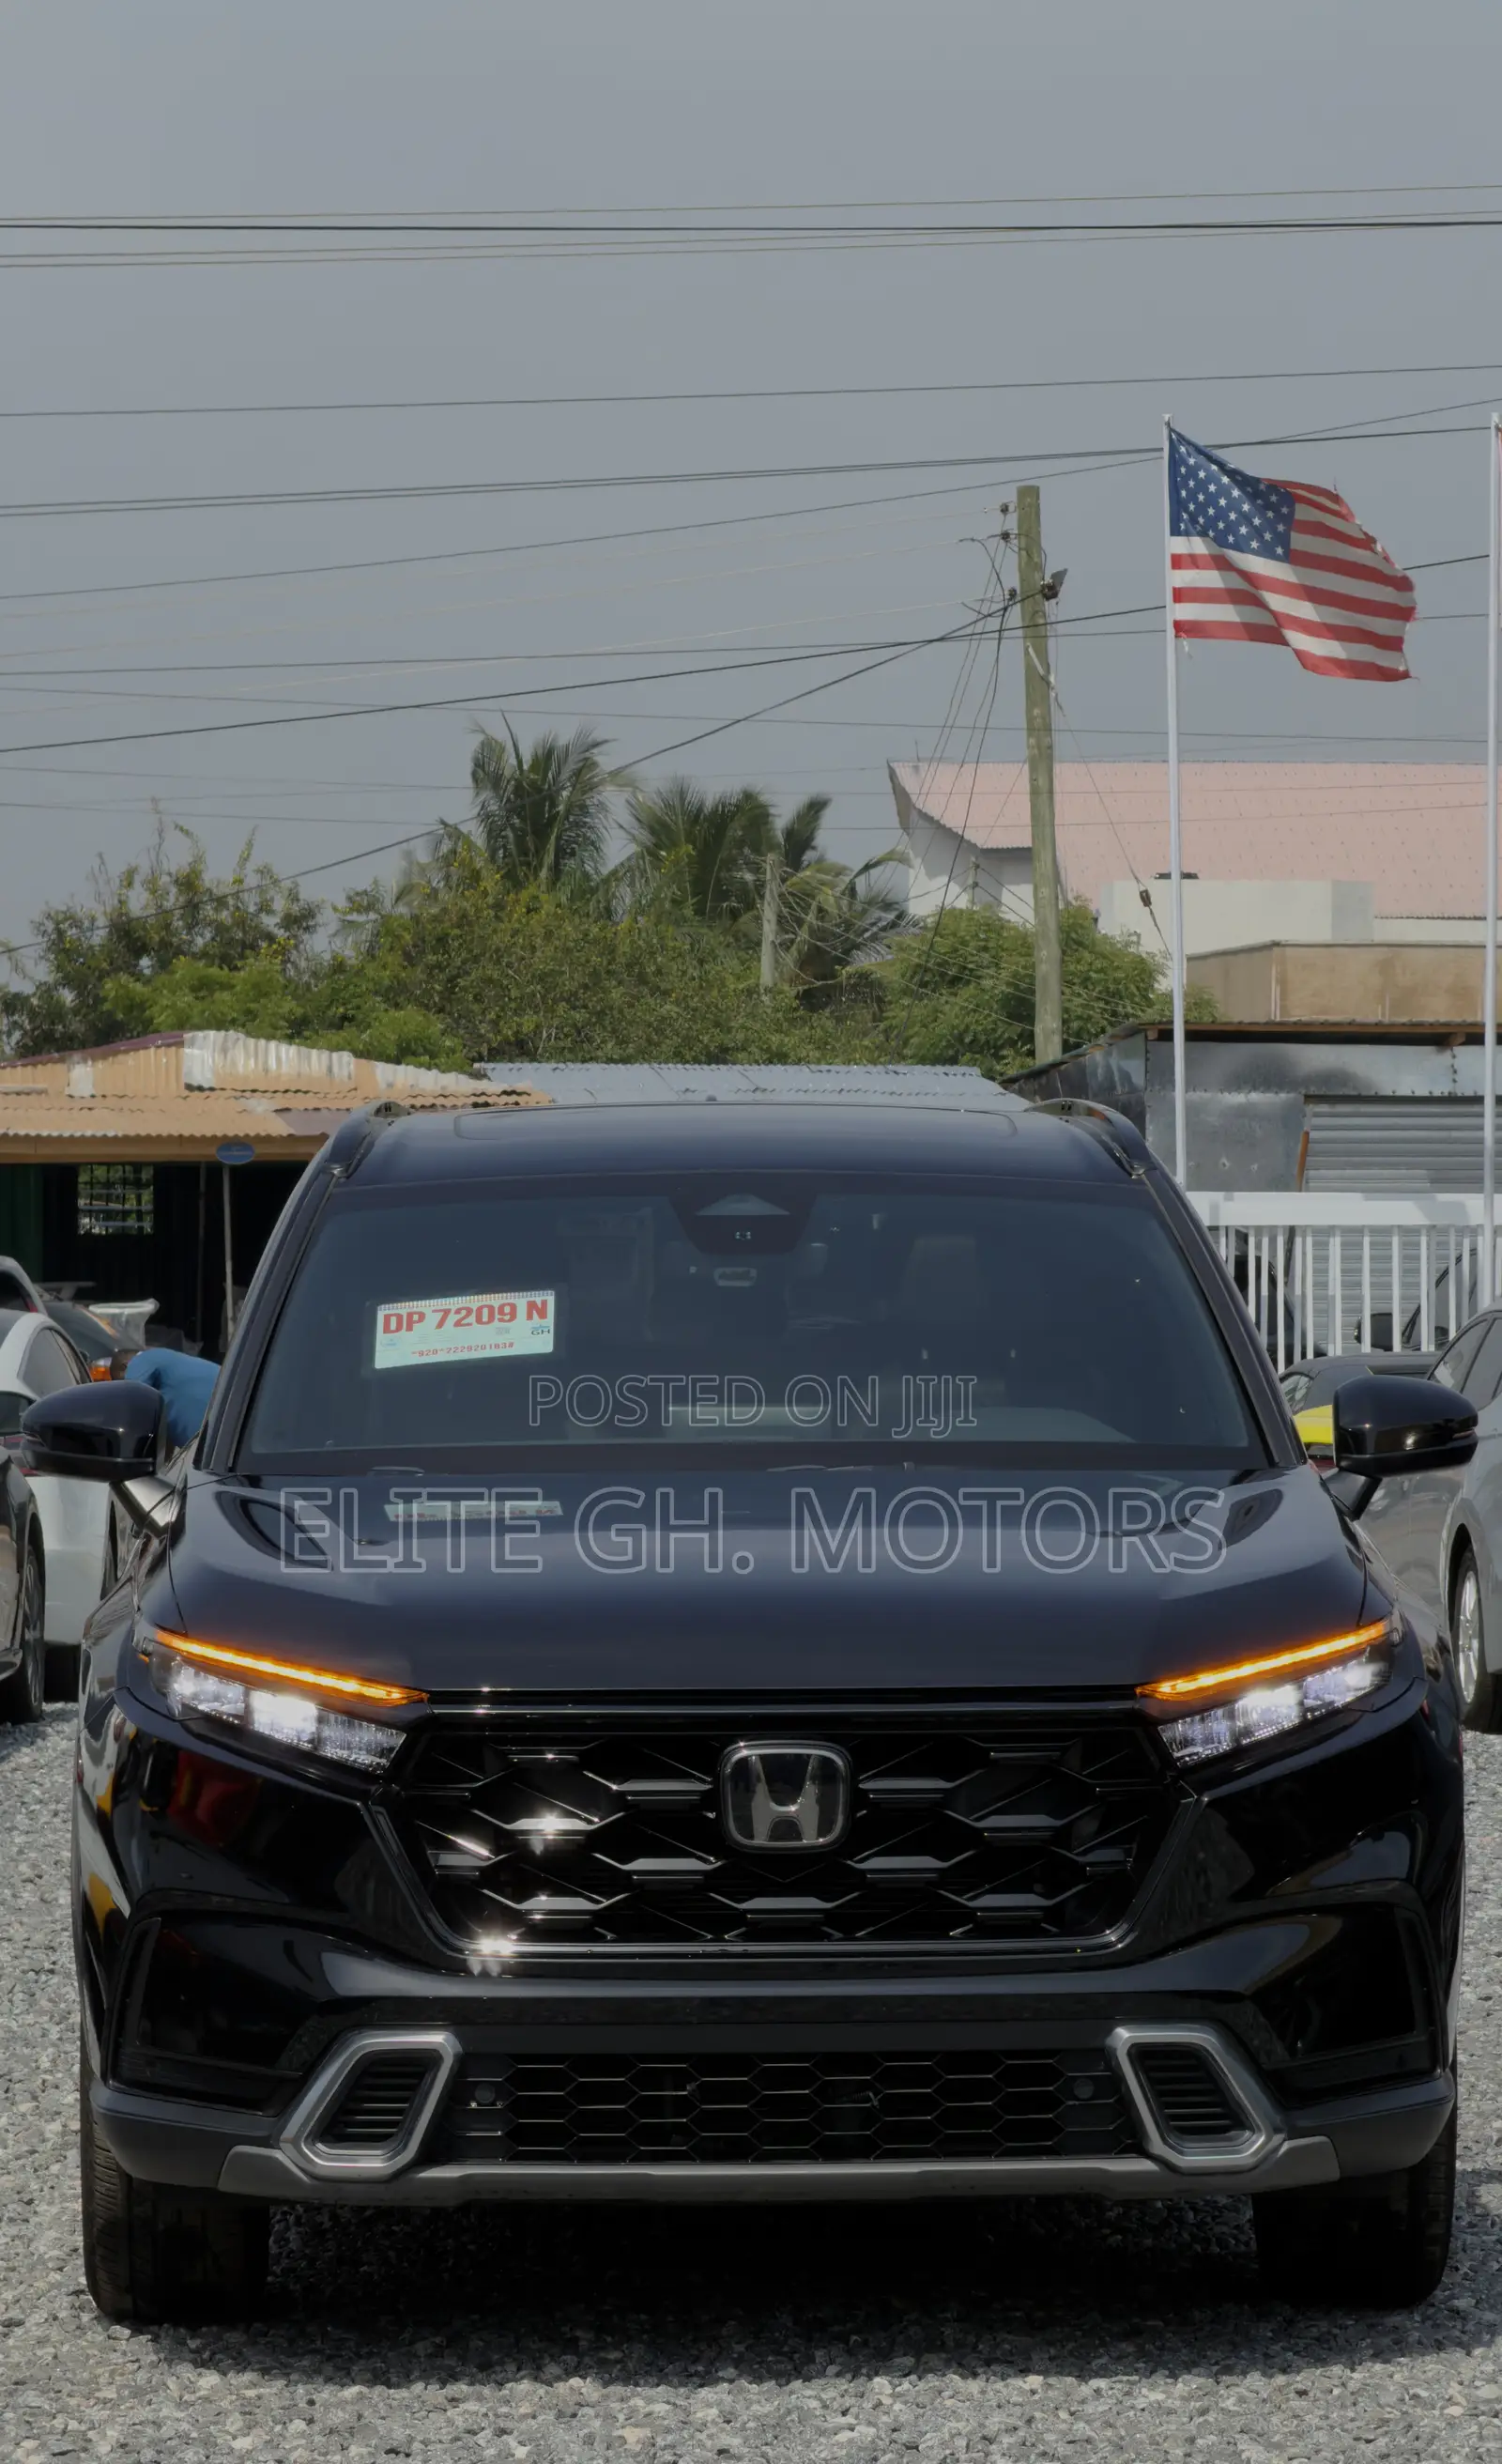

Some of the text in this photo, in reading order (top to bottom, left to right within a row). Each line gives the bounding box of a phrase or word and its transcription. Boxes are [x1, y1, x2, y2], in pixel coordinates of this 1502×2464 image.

[382, 1299, 548, 1334] DP 7209 N
